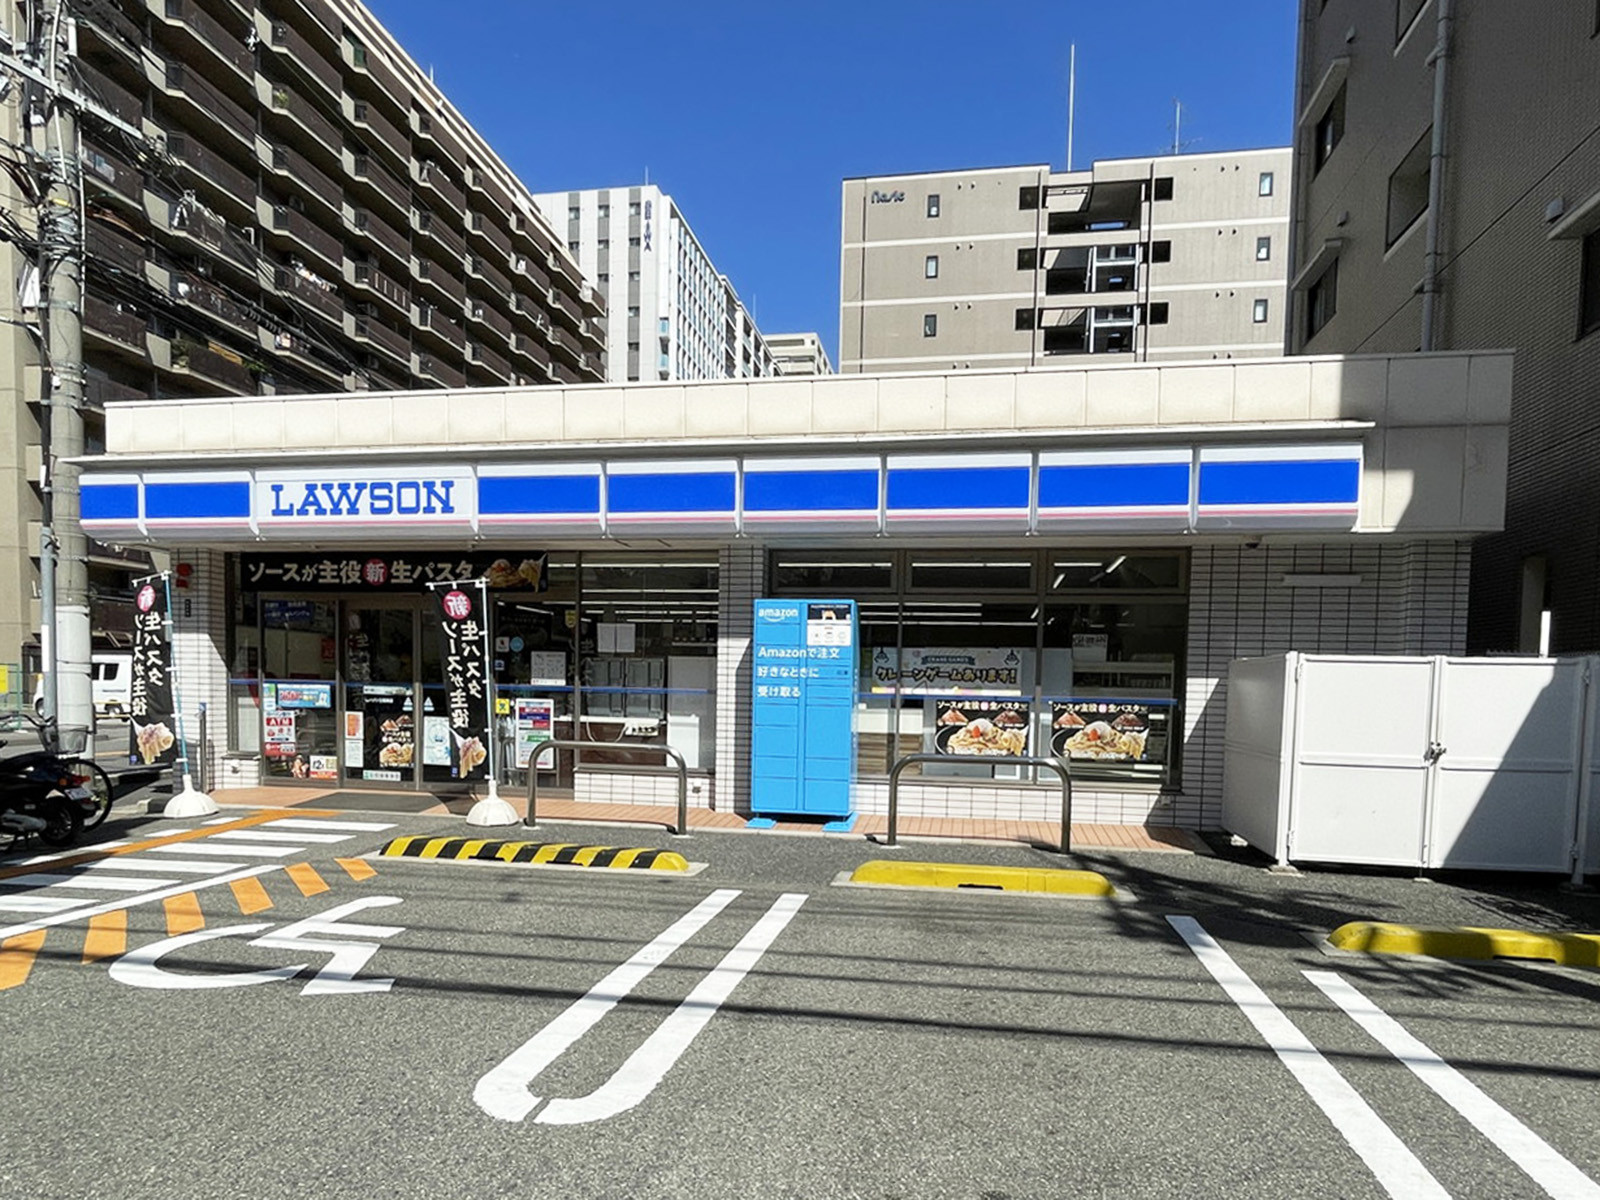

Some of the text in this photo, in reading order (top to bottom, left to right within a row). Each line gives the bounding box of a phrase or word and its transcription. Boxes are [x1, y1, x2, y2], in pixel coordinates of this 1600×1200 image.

[271, 480, 455, 516] LAWSON
[758, 609, 799, 619] amazon
[757, 646, 841, 659] Amazonで注文
[757, 685, 802, 698] 受け取る
[269, 717, 291, 726] ATM
